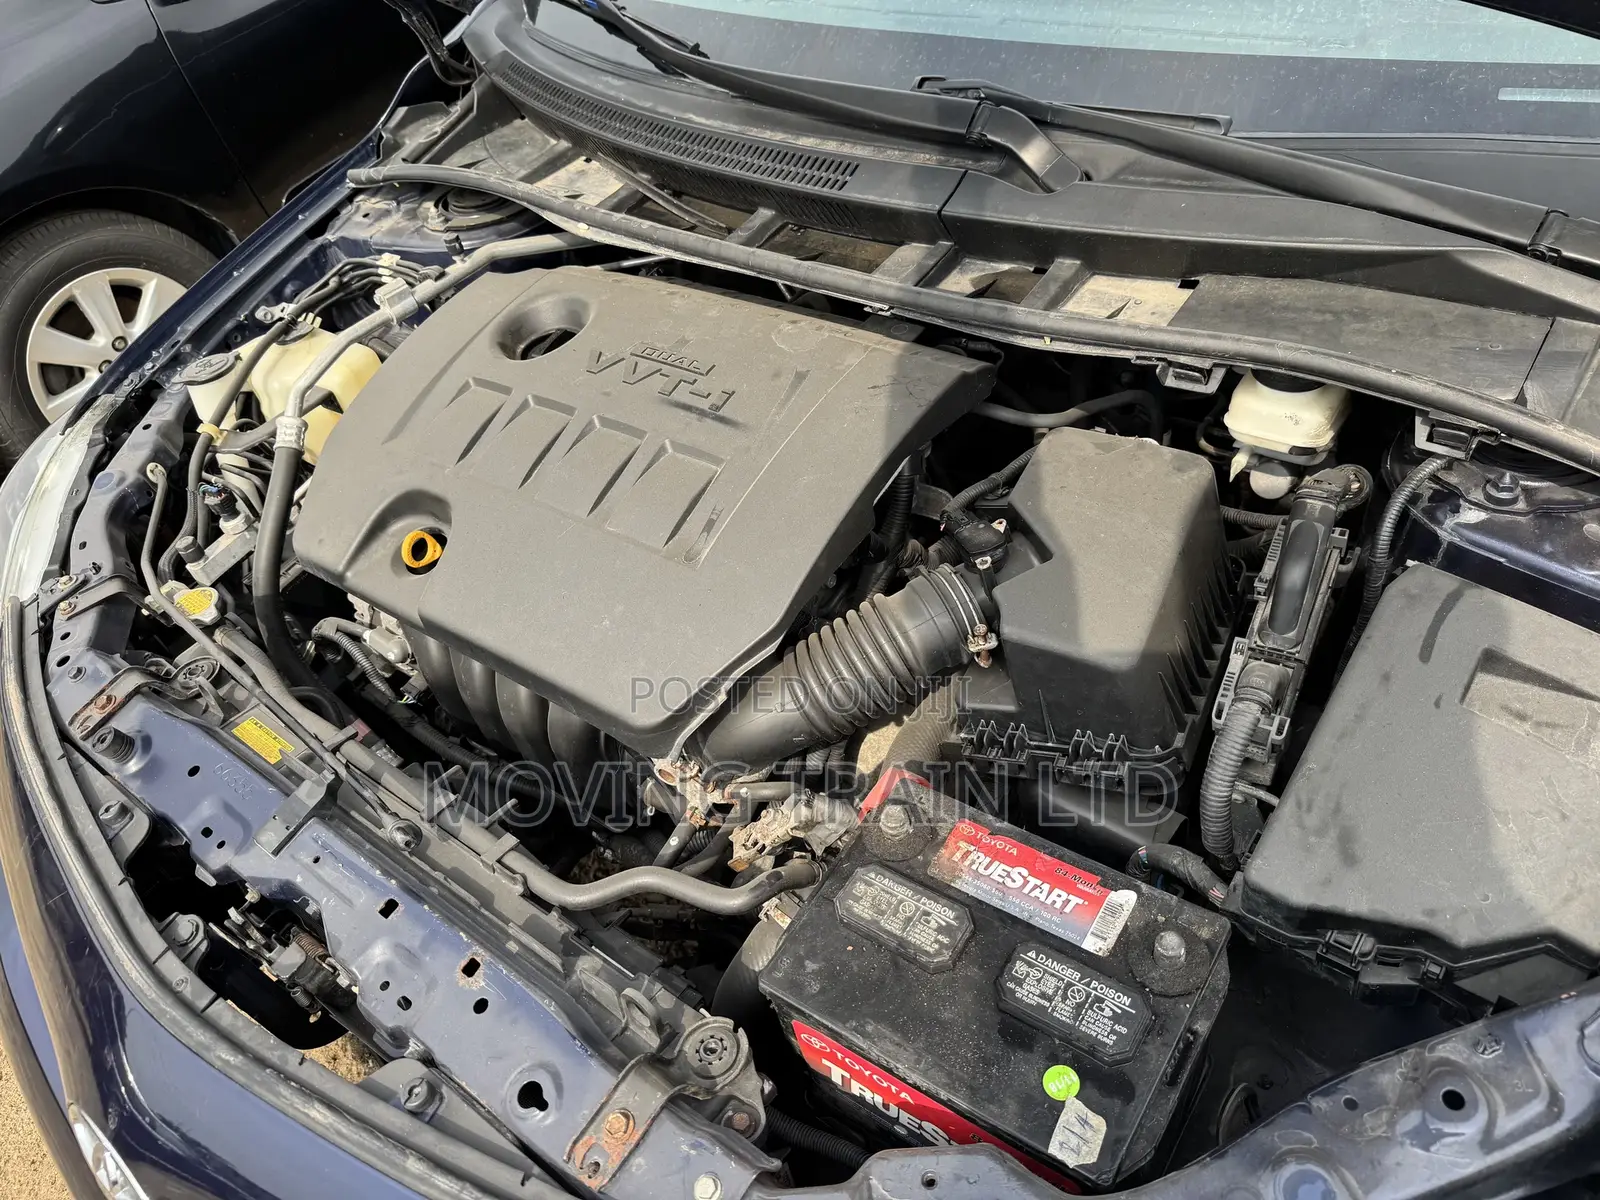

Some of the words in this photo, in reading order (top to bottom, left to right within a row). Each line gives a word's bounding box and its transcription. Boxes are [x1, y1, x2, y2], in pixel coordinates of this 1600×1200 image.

[976, 831, 1017, 856] TOYOTA
[919, 895, 956, 919] POISON
[1020, 901, 1034, 911] CCA
[1036, 953, 1081, 981] DANGER
[1089, 979, 1131, 1006] POISON
[1064, 998, 1076, 1007] NO
[1086, 1009, 1113, 1026] SULFURIC
[1112, 1022, 1128, 1034] ACID
[833, 1049, 915, 1105] TOYOTA
